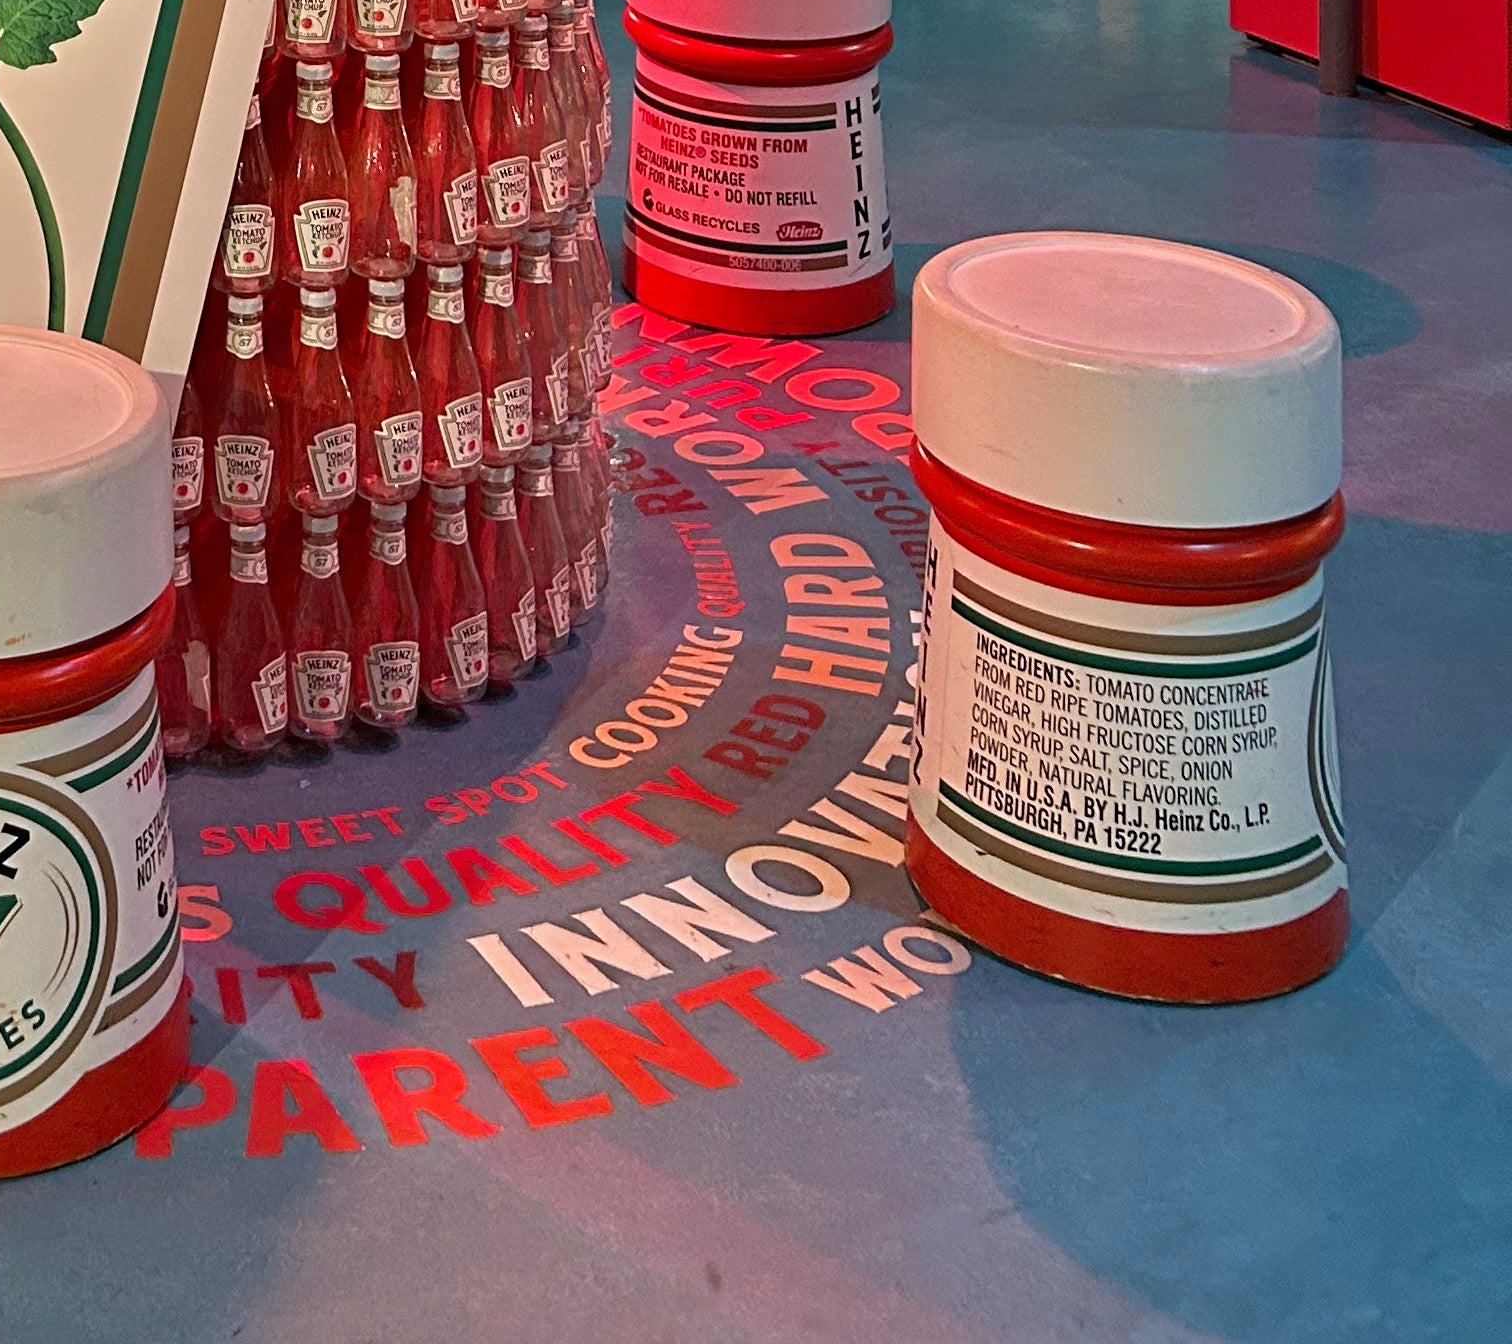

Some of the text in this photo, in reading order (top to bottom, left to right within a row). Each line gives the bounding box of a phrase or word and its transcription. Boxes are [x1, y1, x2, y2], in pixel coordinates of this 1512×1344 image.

[636, 142, 746, 187] RESTAURANT PACKAGE
[701, 130, 757, 151] GROWN
[762, 138, 808, 153] FROM
[710, 149, 760, 169] SEEDS
[845, 96, 872, 260] HEINZ
[648, 166, 666, 187] FOR
[667, 175, 710, 199] RESALE
[725, 188, 743, 204] DO
[747, 191, 772, 206] NOT
[776, 190, 818, 206] REFILL
[655, 202, 761, 234] GLASS RECYCLES
[779, 223, 821, 240] Heinz
[226, 443, 261, 457] HEINZ
[671, 520, 746, 618] QUALITY
[769, 532, 890, 698] HARD
[308, 657, 340, 672] HEINZ
[975, 654, 1268, 734] FROM RED RIPE TOMATOES, DISTILLED
[976, 631, 1270, 706] INGREDIENTS: TOMATO CONCENTRATE
[200, 805, 405, 856] SWEET
[424, 760, 570, 826] SPOT
[569, 624, 744, 769] COOKING
[702, 693, 828, 779] RED
[972, 702, 1234, 783] CORN SYRUP, SALT, SPICE, ONION
[973, 678, 1278, 757] VINEGAR, HIGH FRUCTOSE CORN SYRUP,
[967, 748, 1271, 834] MFD. IN U.S.A. BY H.J. Heinz Co., L.P.
[970, 725, 1222, 807] POWDER, NATURAL FLAVORING.
[272, 763, 742, 934] QUALITY
[965, 771, 1162, 856] PITTSBURGH, PA 15222
